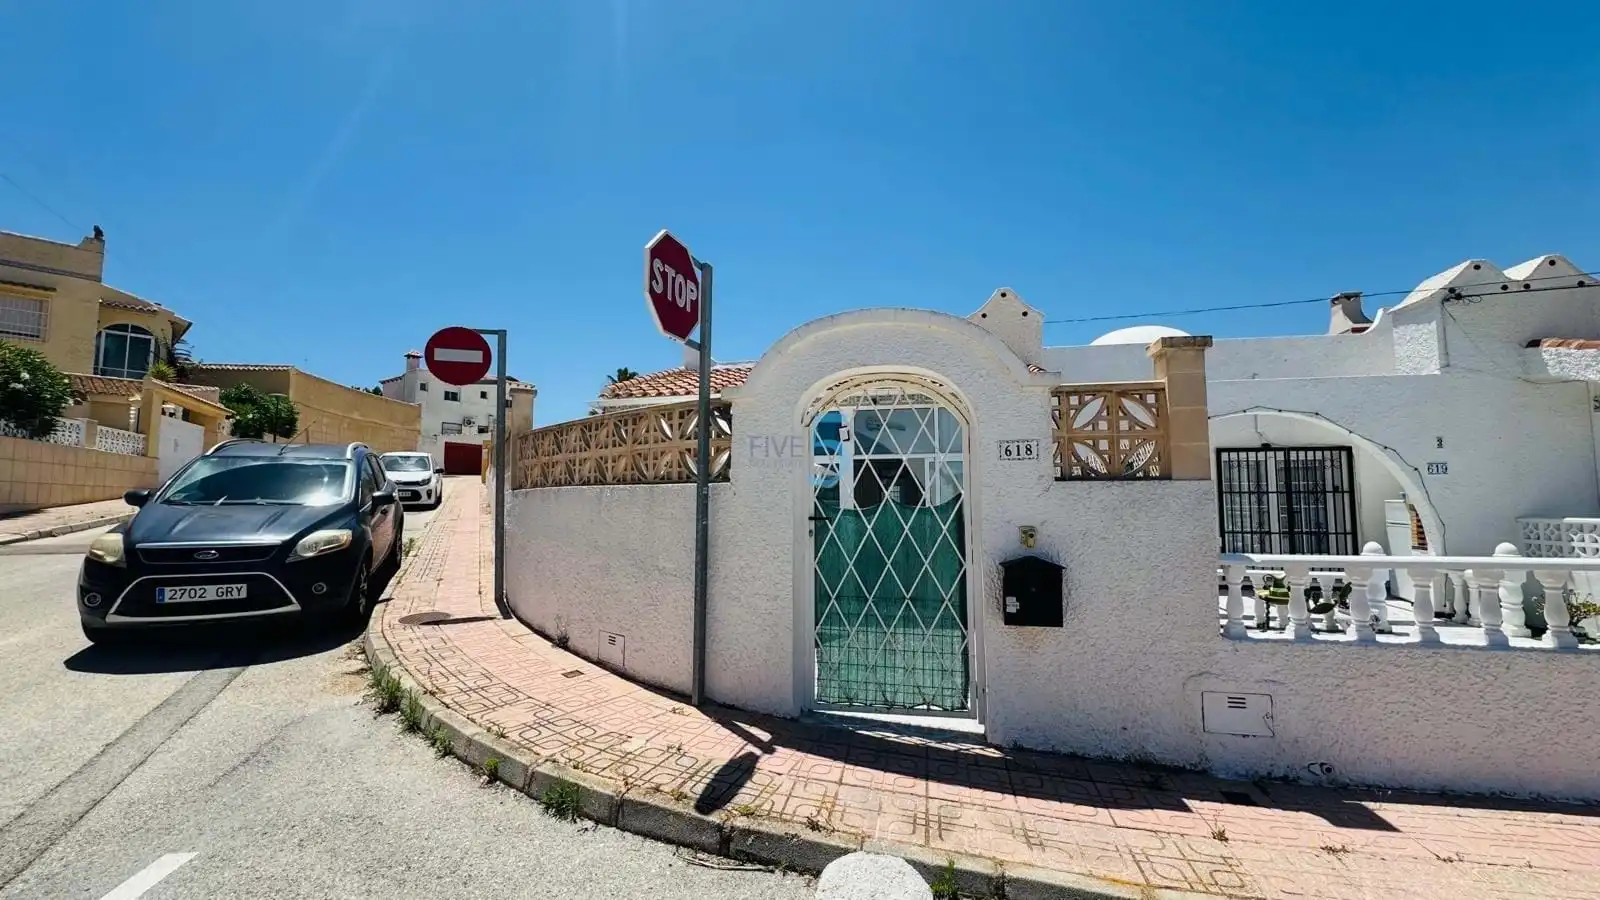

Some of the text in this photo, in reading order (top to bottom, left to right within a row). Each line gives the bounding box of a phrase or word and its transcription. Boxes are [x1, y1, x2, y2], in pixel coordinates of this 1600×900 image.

[652, 258, 697, 312] STOP
[1004, 443, 1034, 457] 618
[1427, 463, 1448, 475] 619
[168, 585, 244, 601] 2702 GRY
